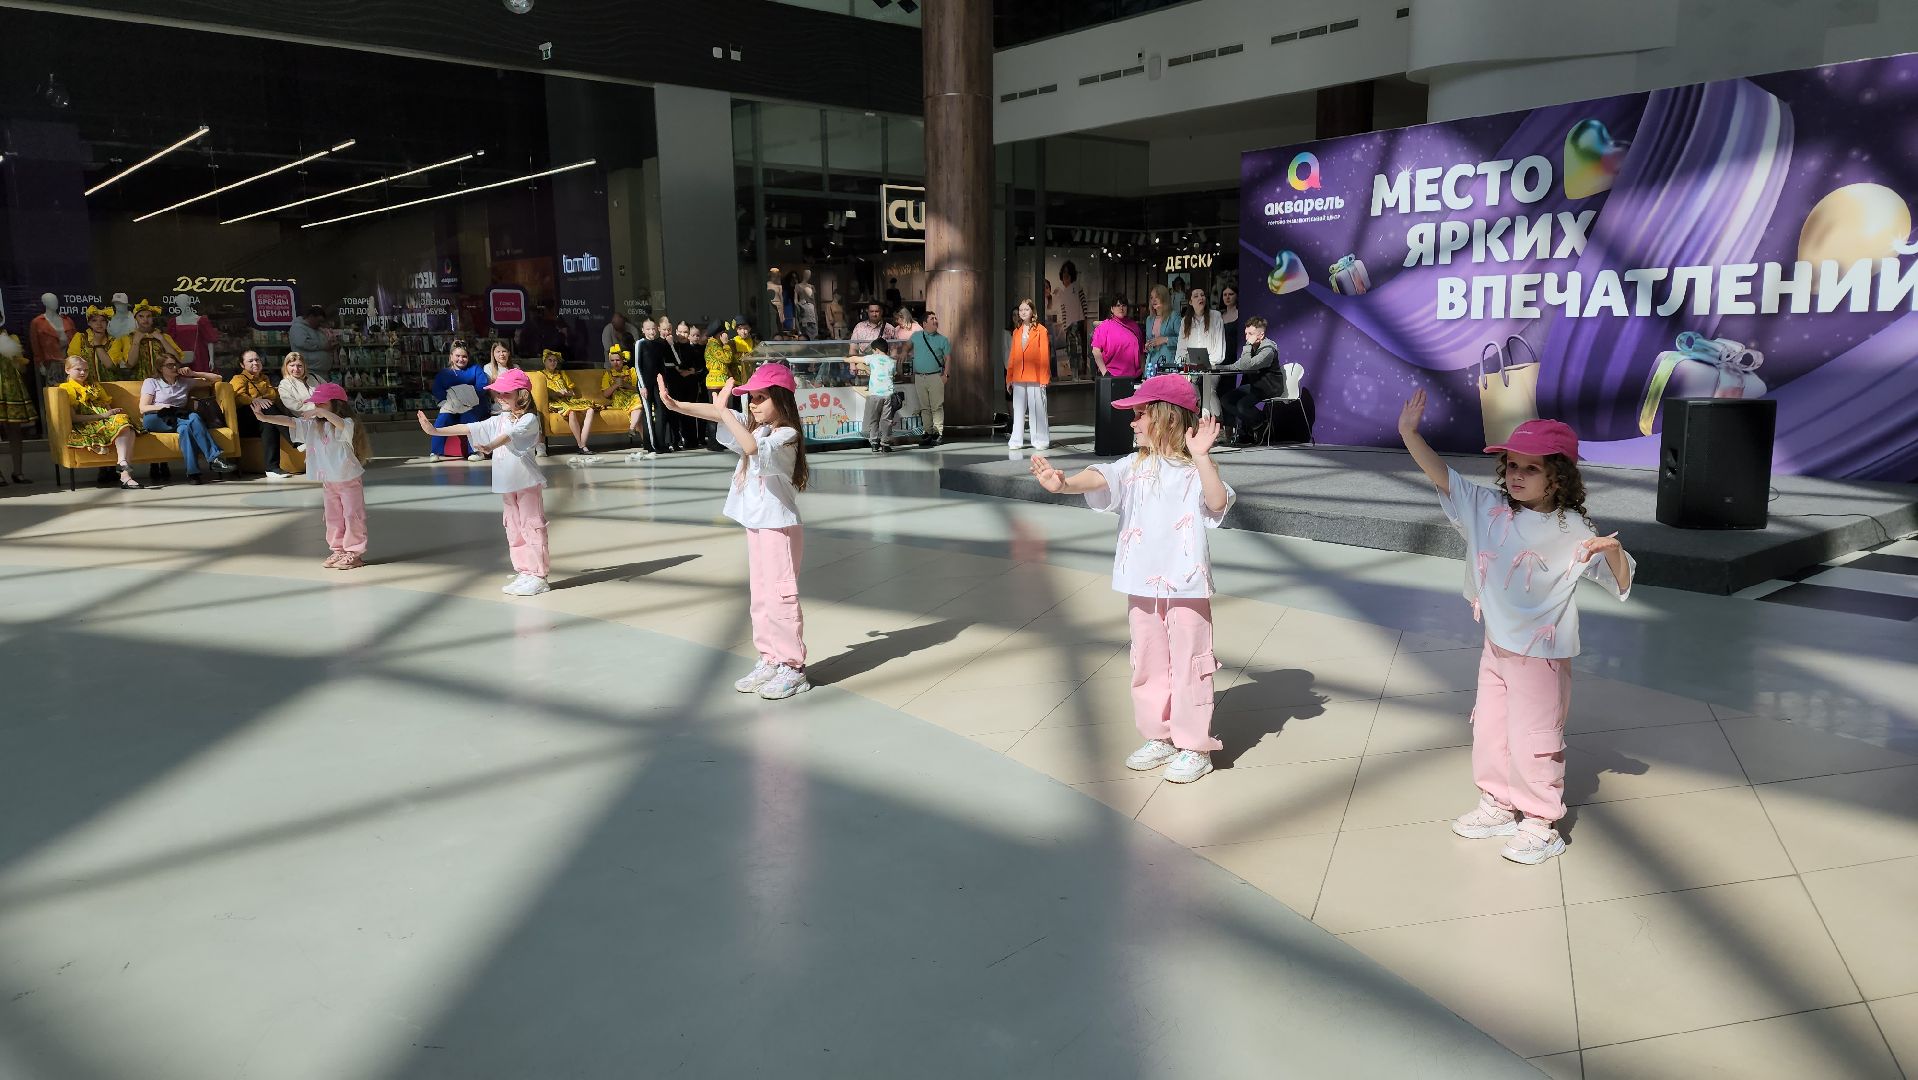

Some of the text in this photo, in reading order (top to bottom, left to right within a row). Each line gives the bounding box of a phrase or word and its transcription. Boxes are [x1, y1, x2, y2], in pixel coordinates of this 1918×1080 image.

[1370, 154, 1553, 216] МЕСТО
[1264, 196, 1345, 215] акварель
[1402, 210, 1597, 267] ЯРКИХ
[1436, 237, 1918, 320] ВПЕЧАТЛЕНИЙ
[64, 294, 102, 303] ТОВАРЫ
[162, 295, 201, 304] ОДДА
[59, 306, 79, 315] ДЛЯ
[260, 310, 290, 318] ЦЕНАМ
[338, 307, 379, 316] ДЛЯ ДОА
[808, 392, 831, 410] 50
